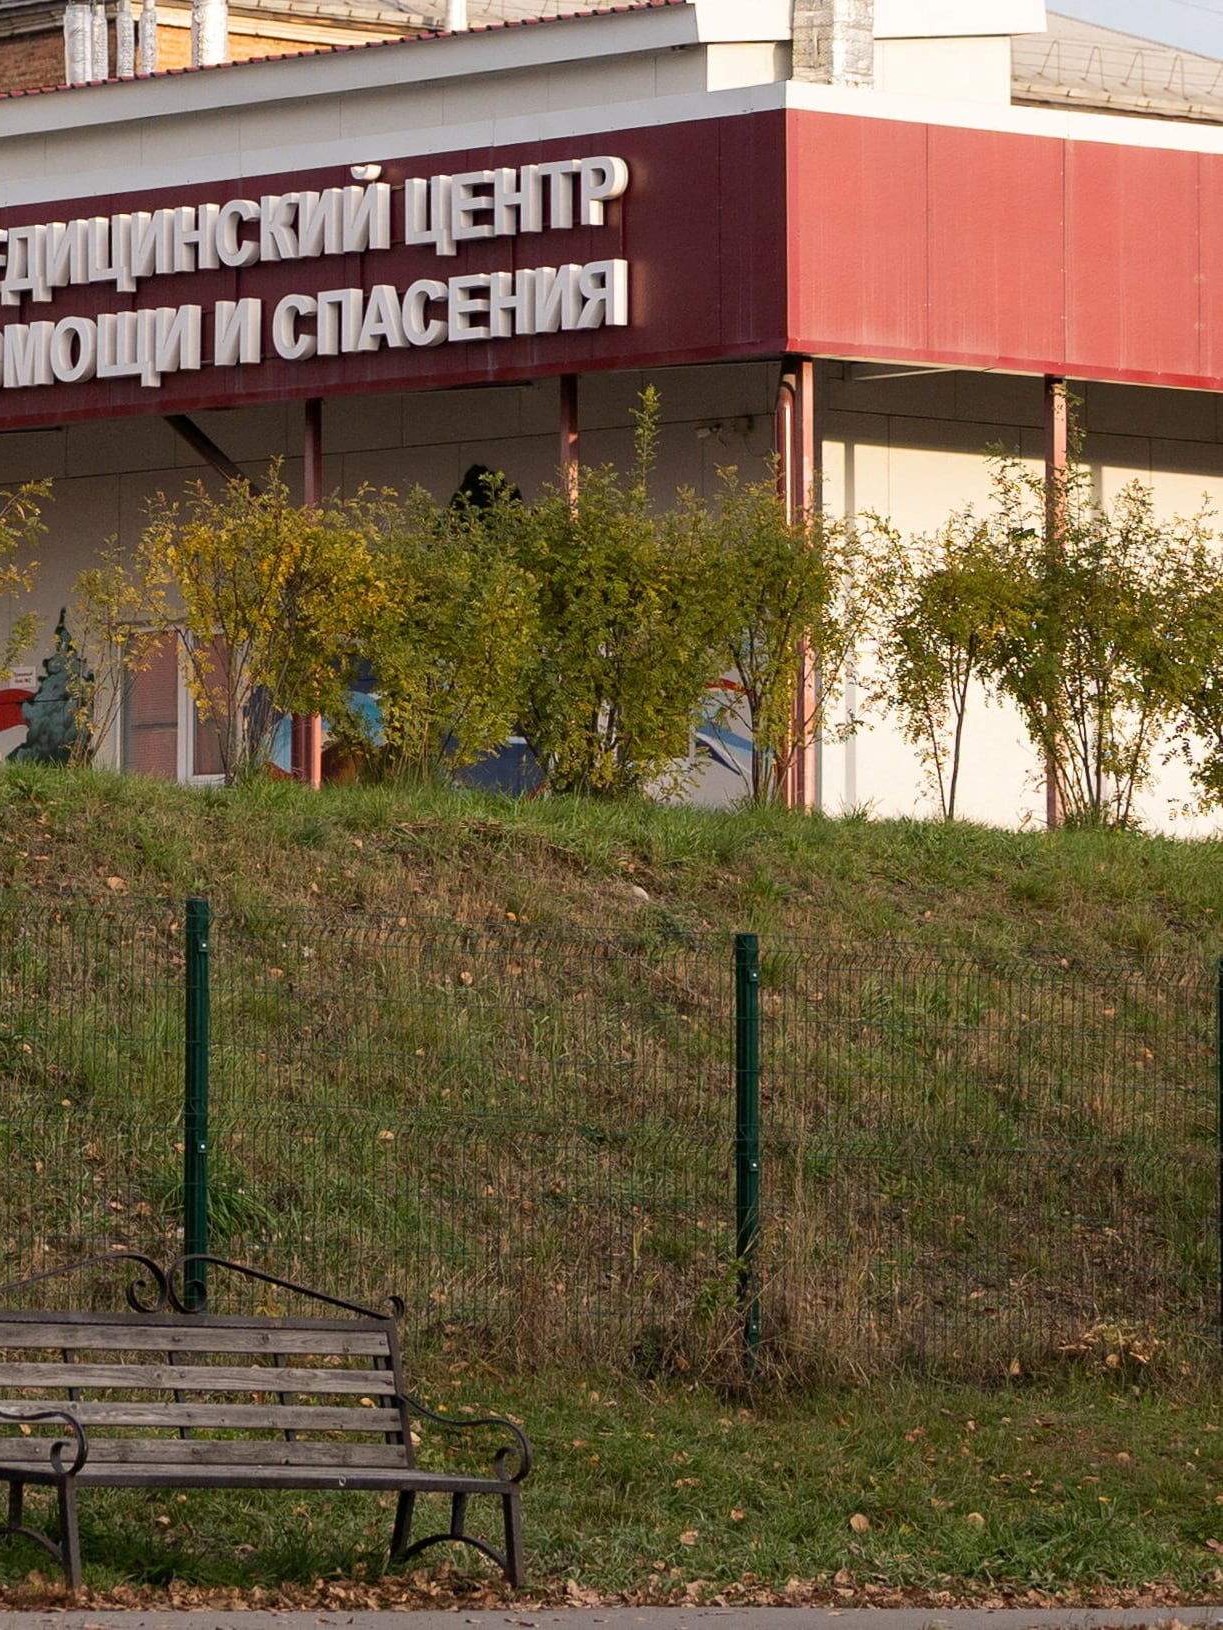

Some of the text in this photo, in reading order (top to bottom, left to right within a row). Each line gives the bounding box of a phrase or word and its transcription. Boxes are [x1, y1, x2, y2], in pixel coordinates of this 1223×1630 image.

[404, 155, 629, 256] ЦЕНТР
[214, 297, 261, 366] И
[273, 258, 629, 361] СПАСЕНИЯ
